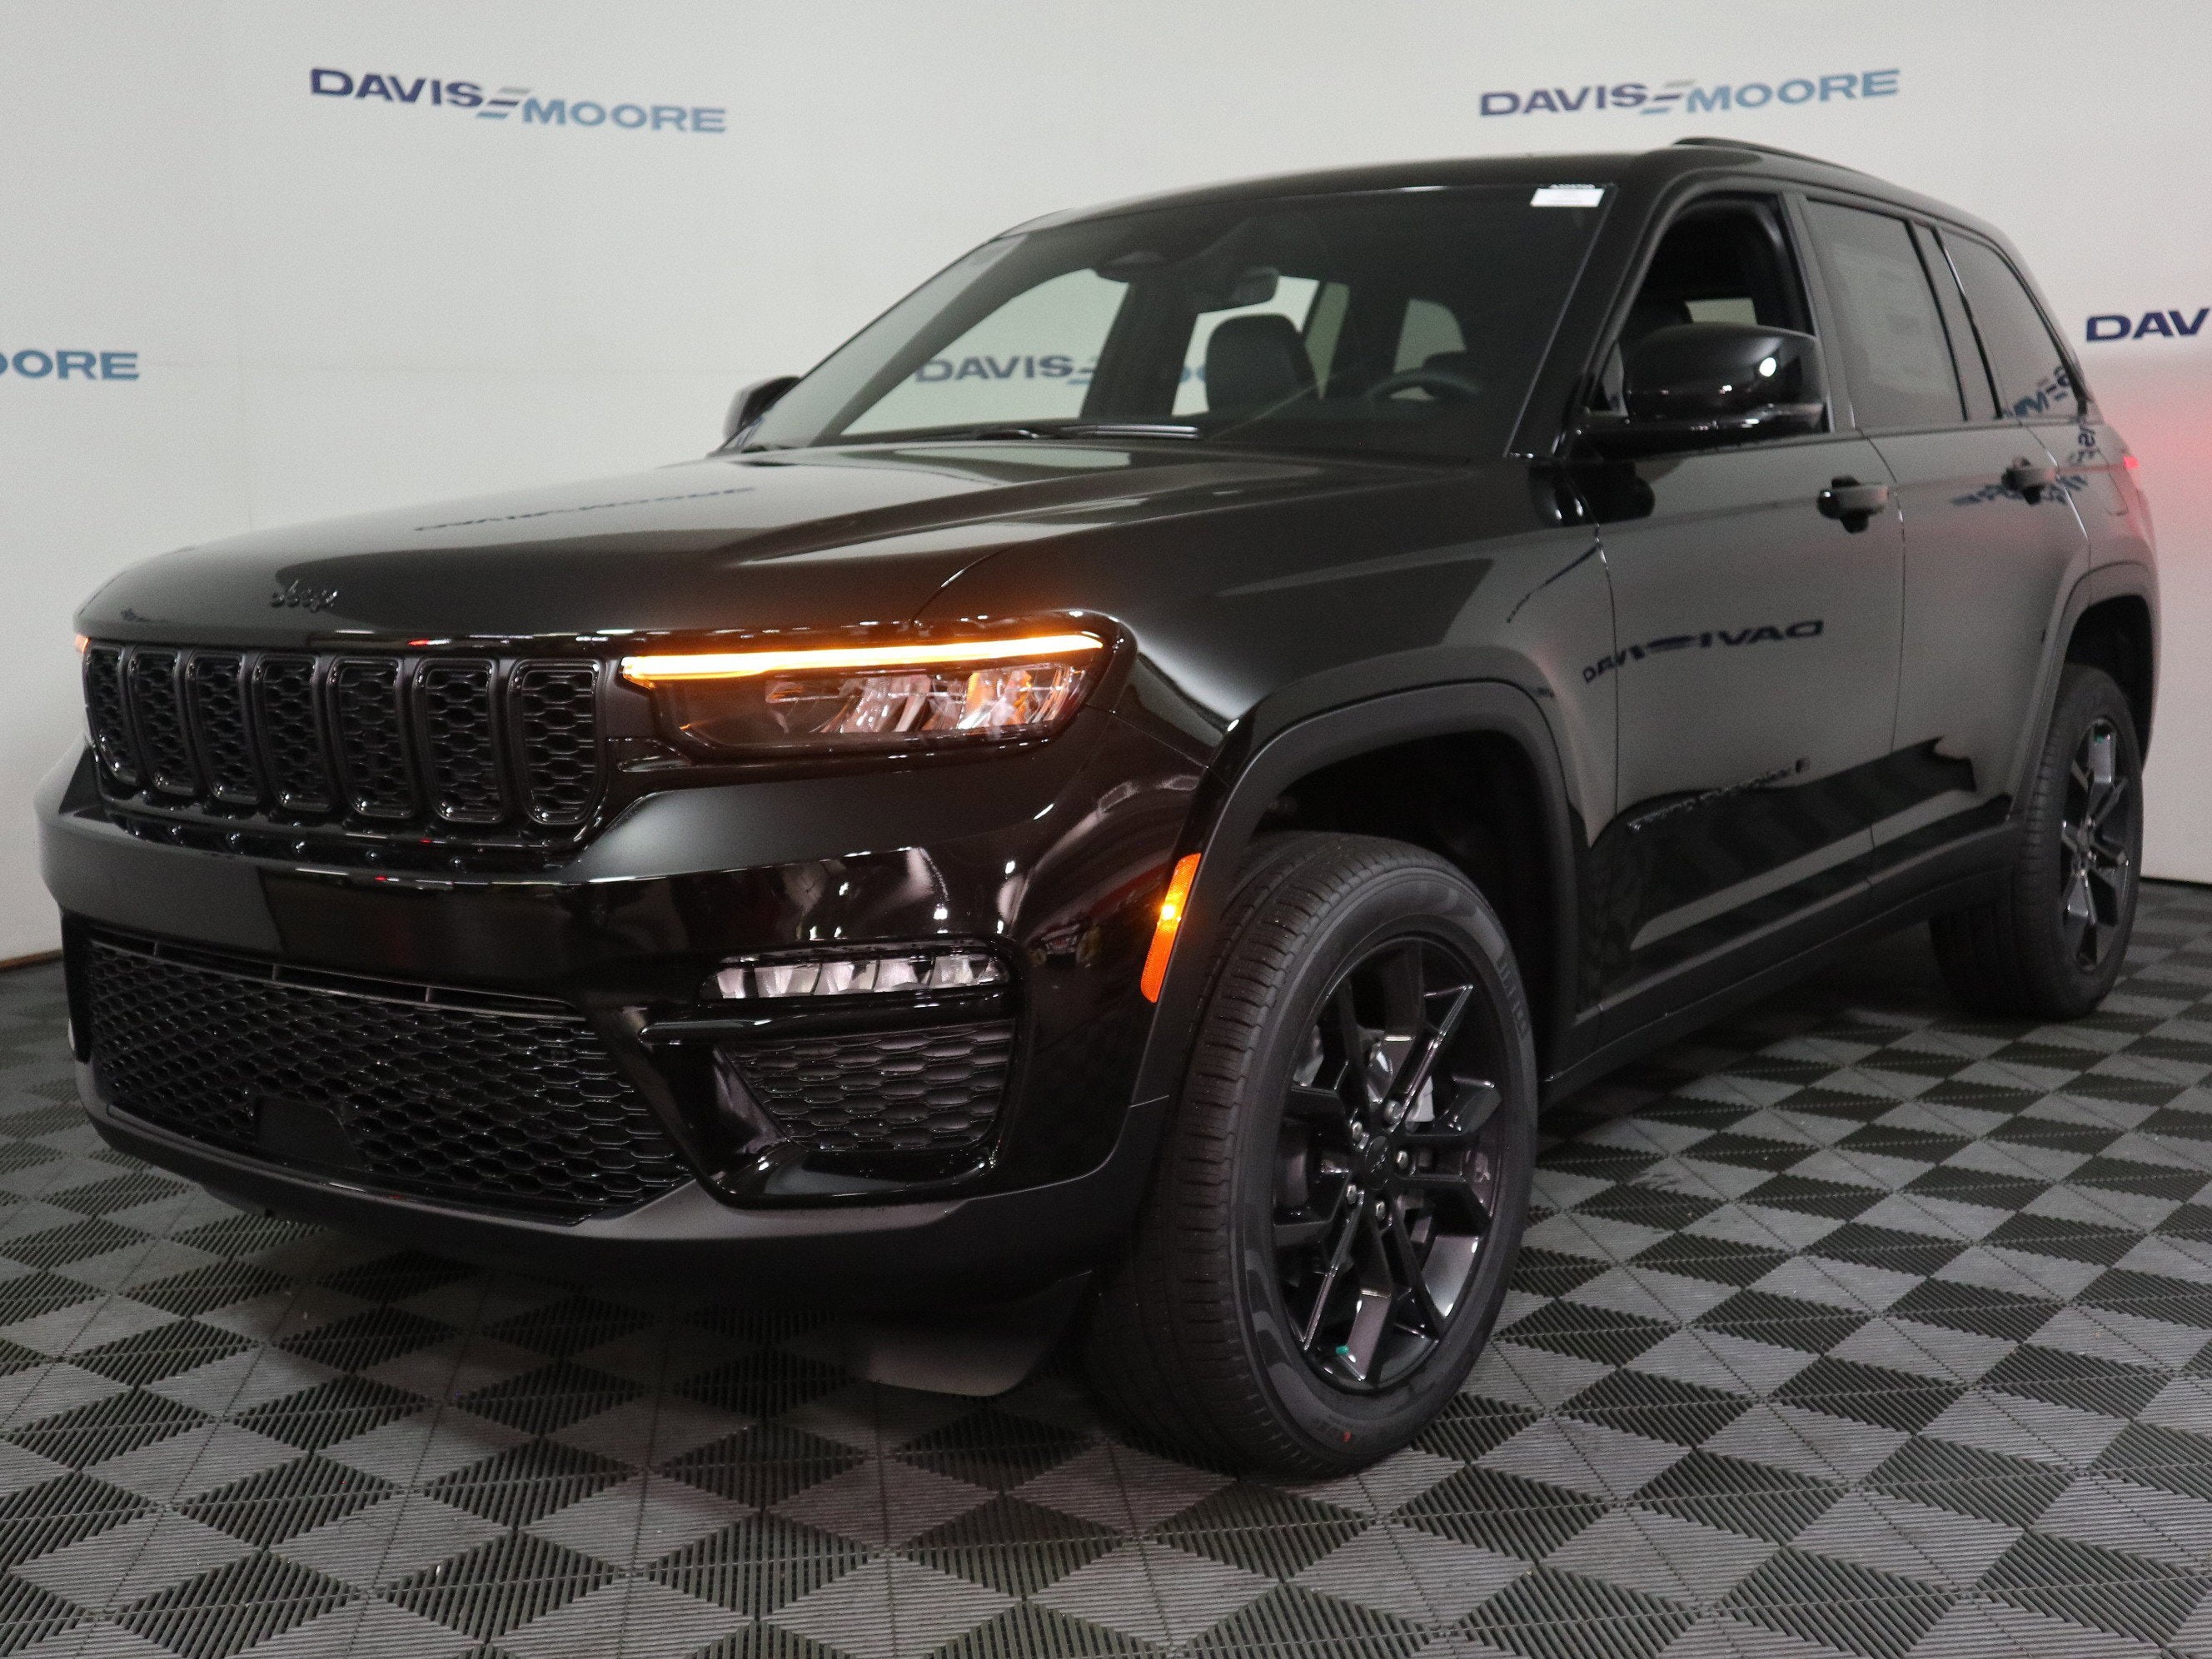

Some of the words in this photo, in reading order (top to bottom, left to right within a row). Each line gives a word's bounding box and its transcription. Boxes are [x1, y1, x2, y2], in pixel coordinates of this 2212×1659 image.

[310, 67, 484, 108] DAVIS
[522, 97, 727, 133] MOORE
[1479, 82, 1647, 117] DAVIS
[1685, 68, 1901, 114] MOORE
[2085, 306, 2210, 342] DAV
[0, 348, 141, 381] ORE
[916, 355, 1074, 383] DAVIS
